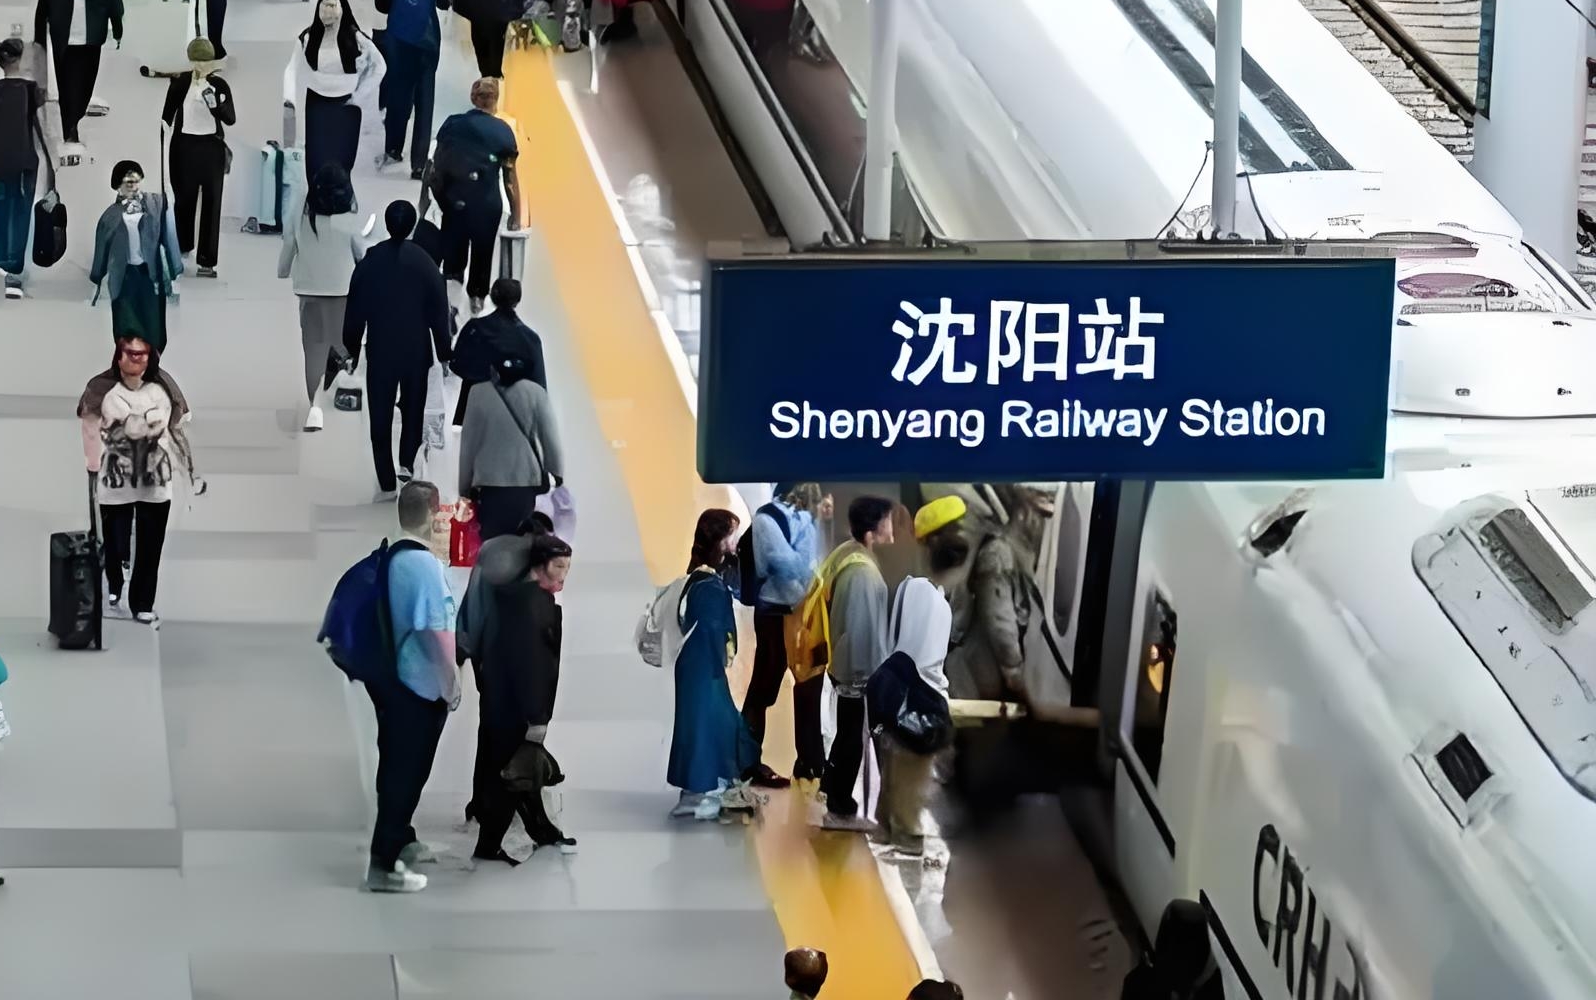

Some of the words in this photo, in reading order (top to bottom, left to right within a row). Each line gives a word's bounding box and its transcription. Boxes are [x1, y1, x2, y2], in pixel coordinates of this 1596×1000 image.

[891, 297, 1165, 386] 沈阳站
[770, 401, 985, 448] Shenyang
[1002, 400, 1168, 447] Railway
[1181, 399, 1326, 438] Station
